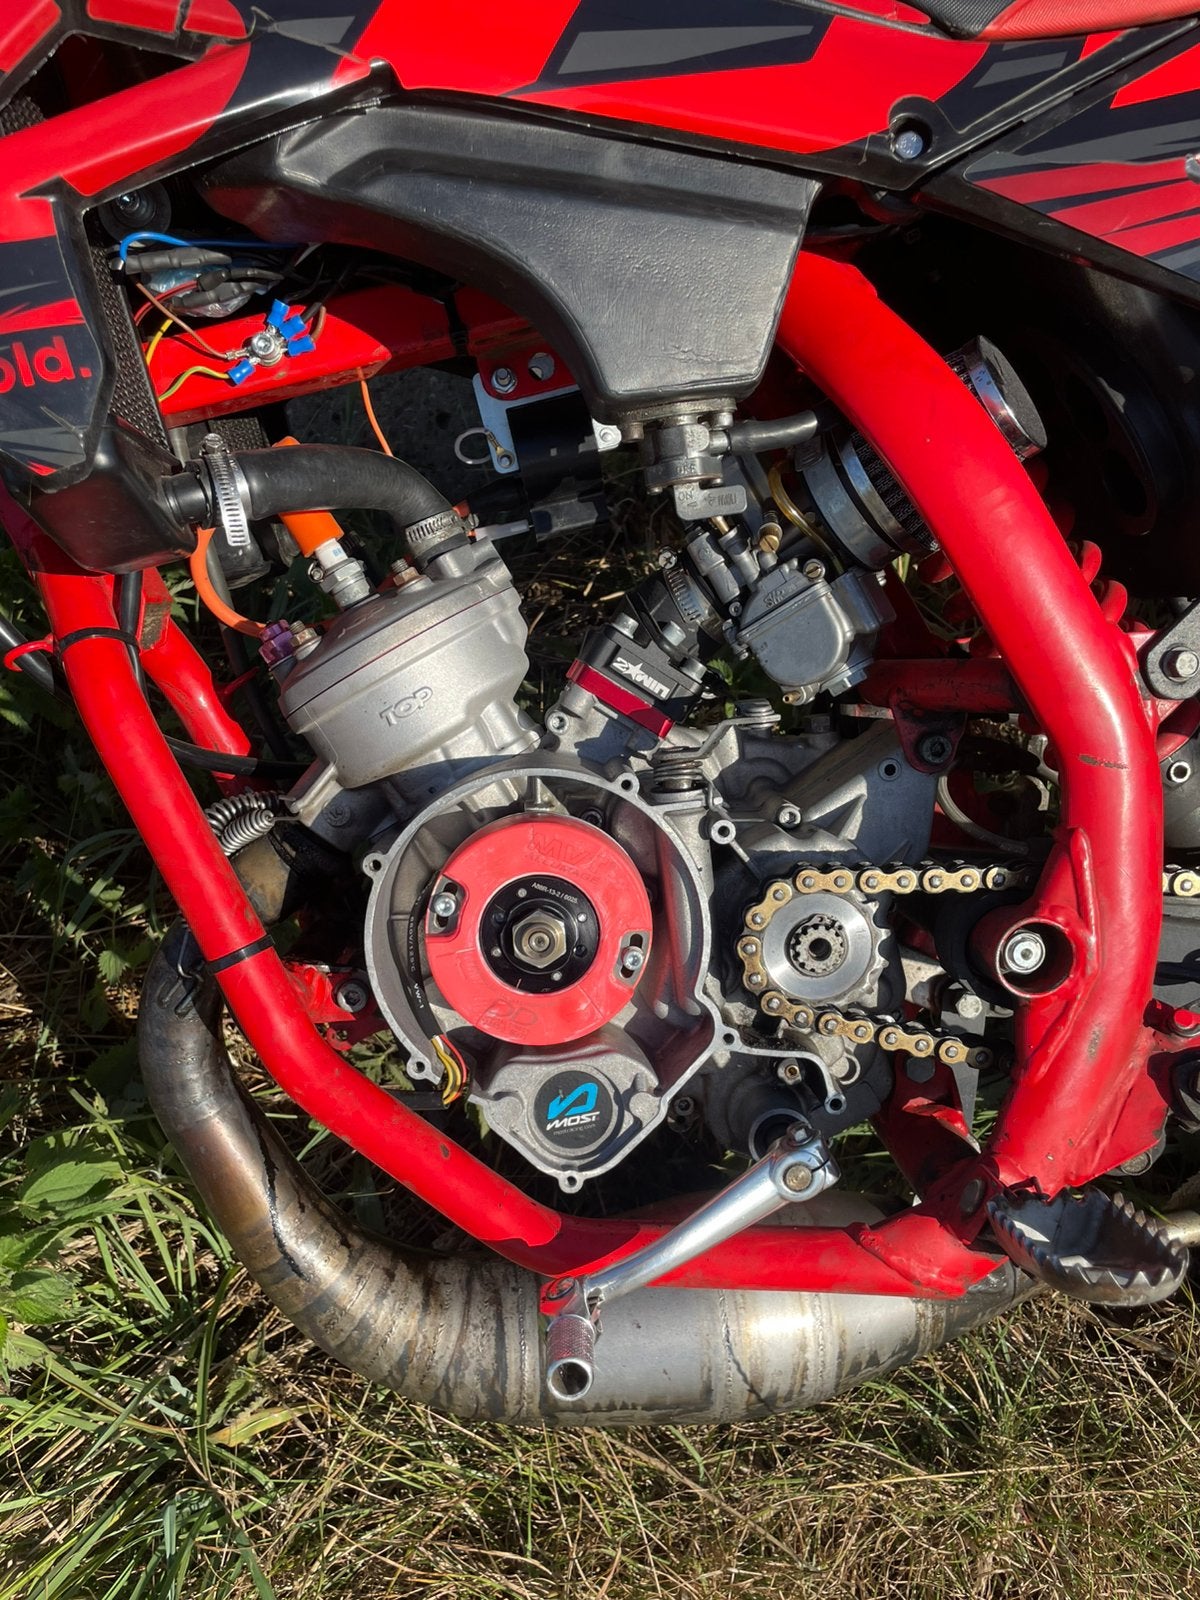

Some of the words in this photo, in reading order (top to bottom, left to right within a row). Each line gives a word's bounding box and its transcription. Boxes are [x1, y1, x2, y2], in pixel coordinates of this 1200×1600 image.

[678, 490, 693, 502] ON
[379, 686, 433, 727] TOP
[546, 1111, 600, 1131] MOST
